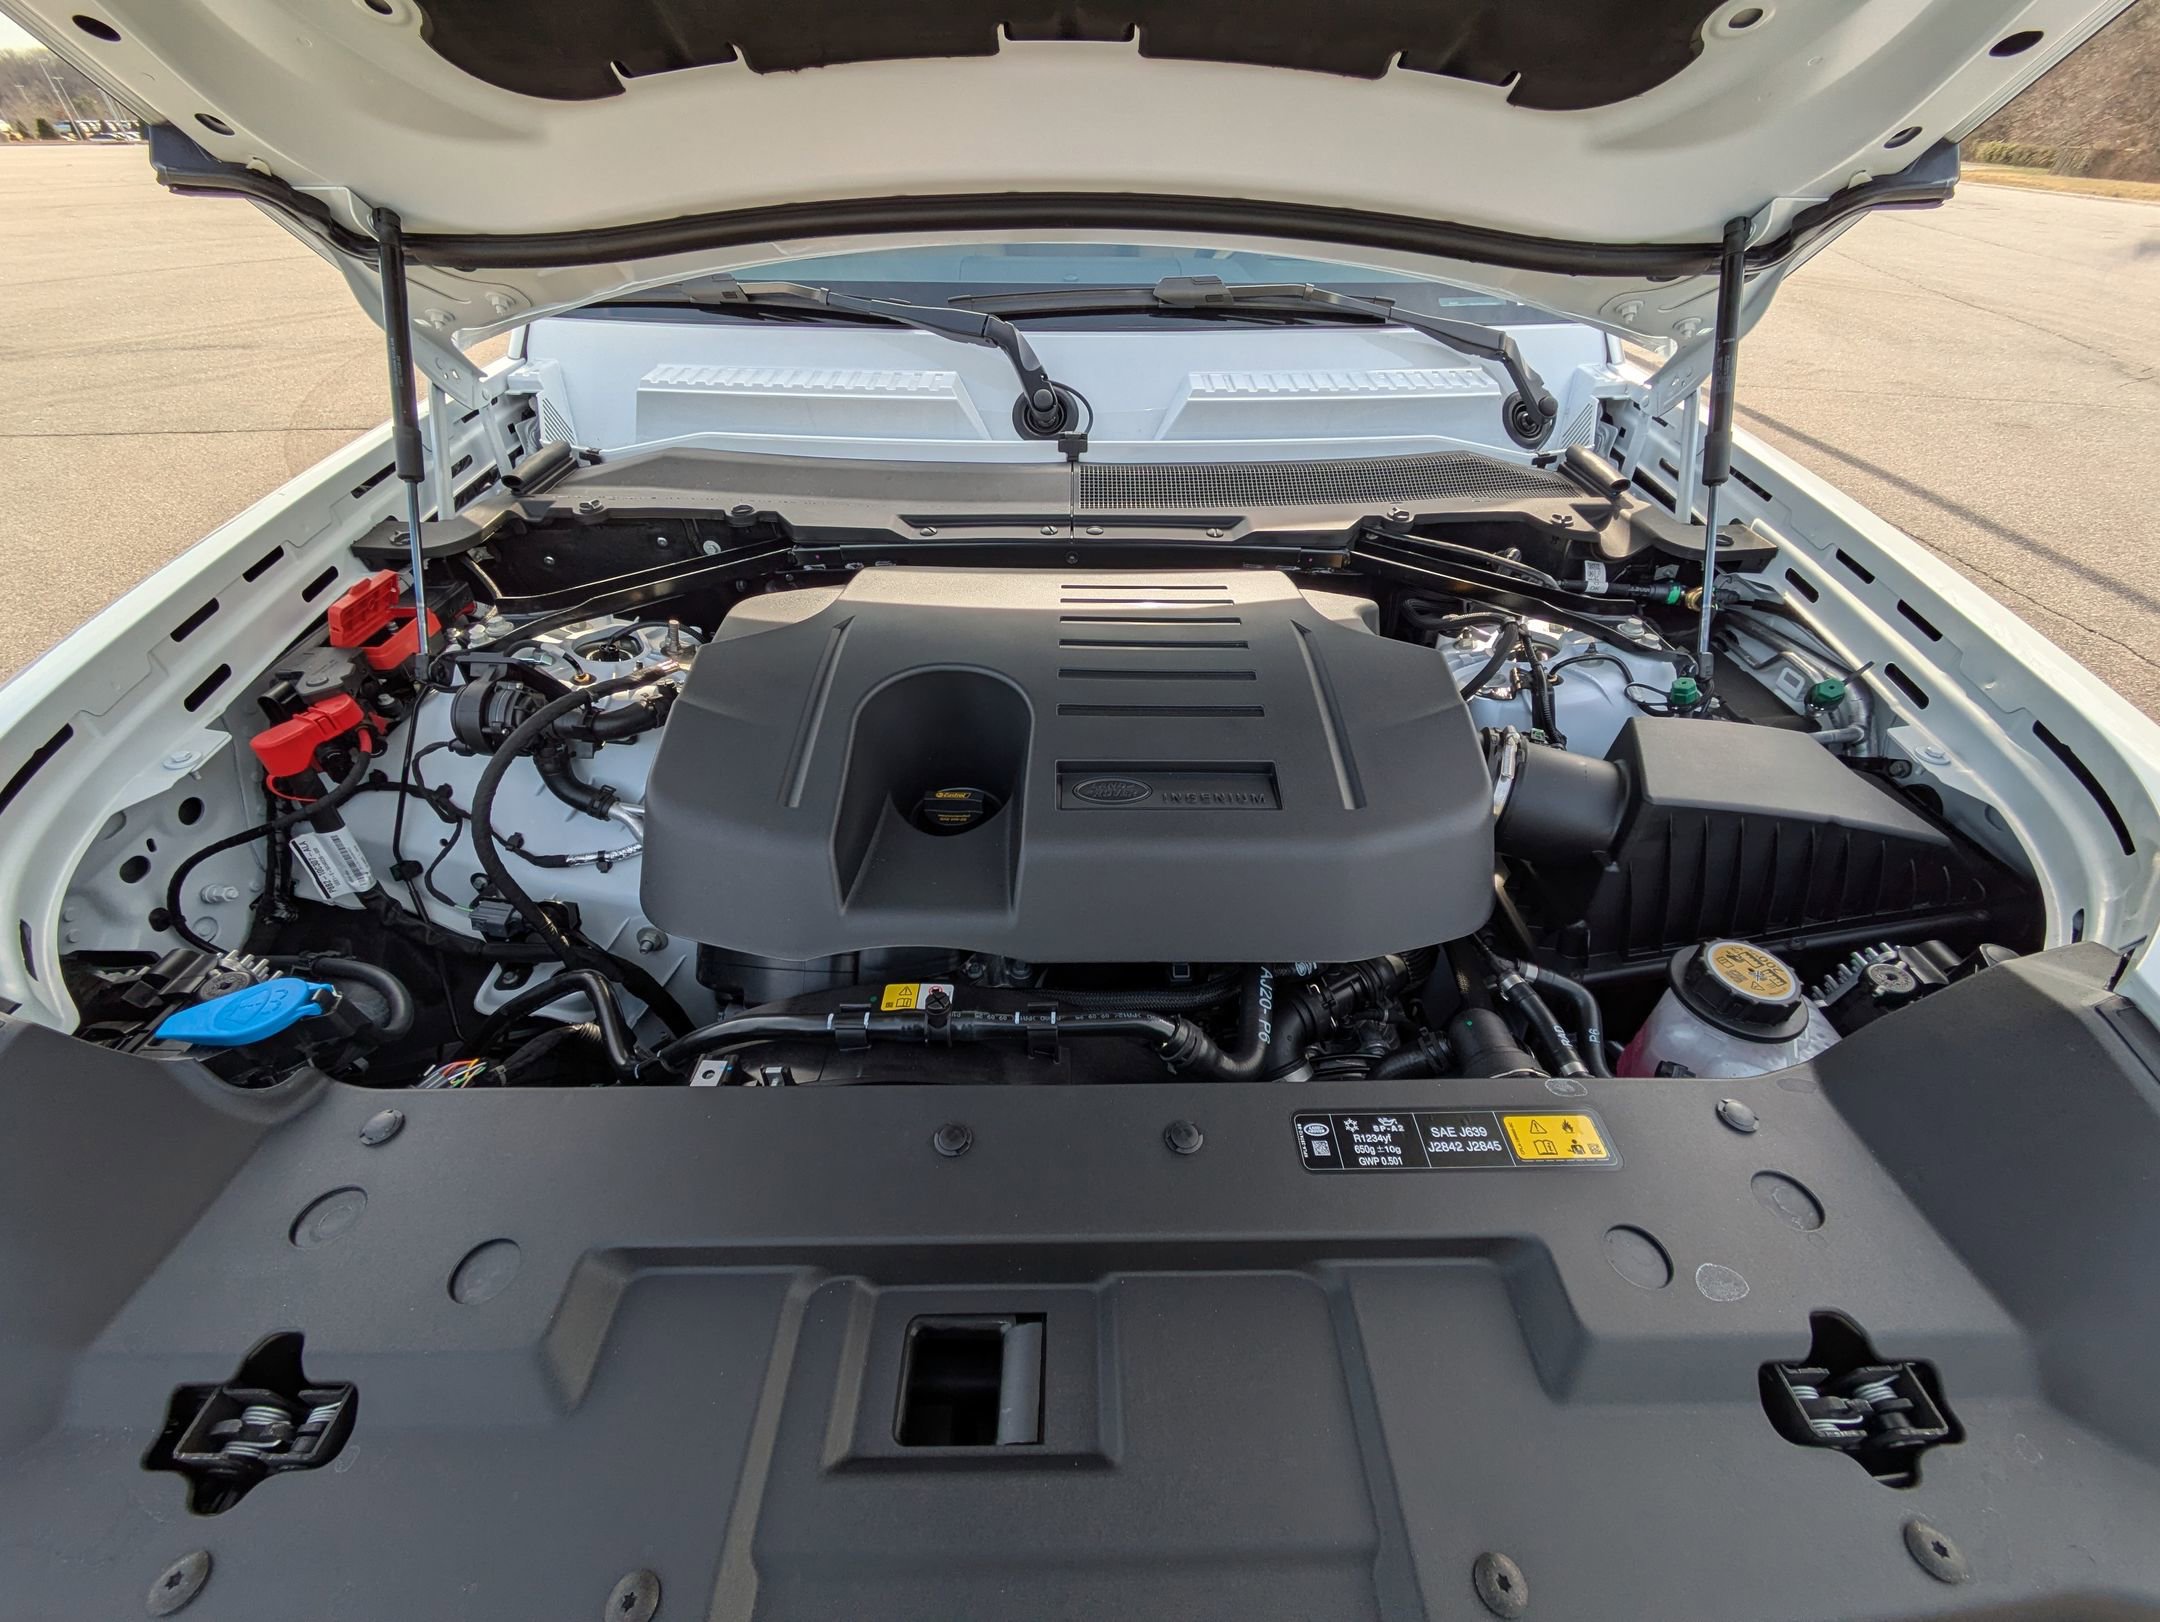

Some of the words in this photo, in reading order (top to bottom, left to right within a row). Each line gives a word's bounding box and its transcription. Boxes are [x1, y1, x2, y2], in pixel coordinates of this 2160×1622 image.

[1162, 792, 1266, 804] INGENIUM
[1258, 1018, 1272, 1044] P6
[1553, 1025, 1573, 1048] RAD
[1588, 1028, 1600, 1043] P6
[1372, 1124, 1405, 1132] SP-A2
[1430, 1126, 1458, 1138] SAE
[1459, 1126, 1488, 1137] J639
[1352, 1133, 1392, 1144] R1234yf
[1354, 1144, 1376, 1155] 650g
[1377, 1145, 1402, 1154] ±10g
[1428, 1141, 1464, 1152] J2842
[1466, 1140, 1503, 1152] J2845
[1358, 1156, 1379, 1166] GWP
[1381, 1156, 1404, 1166] 0.501
